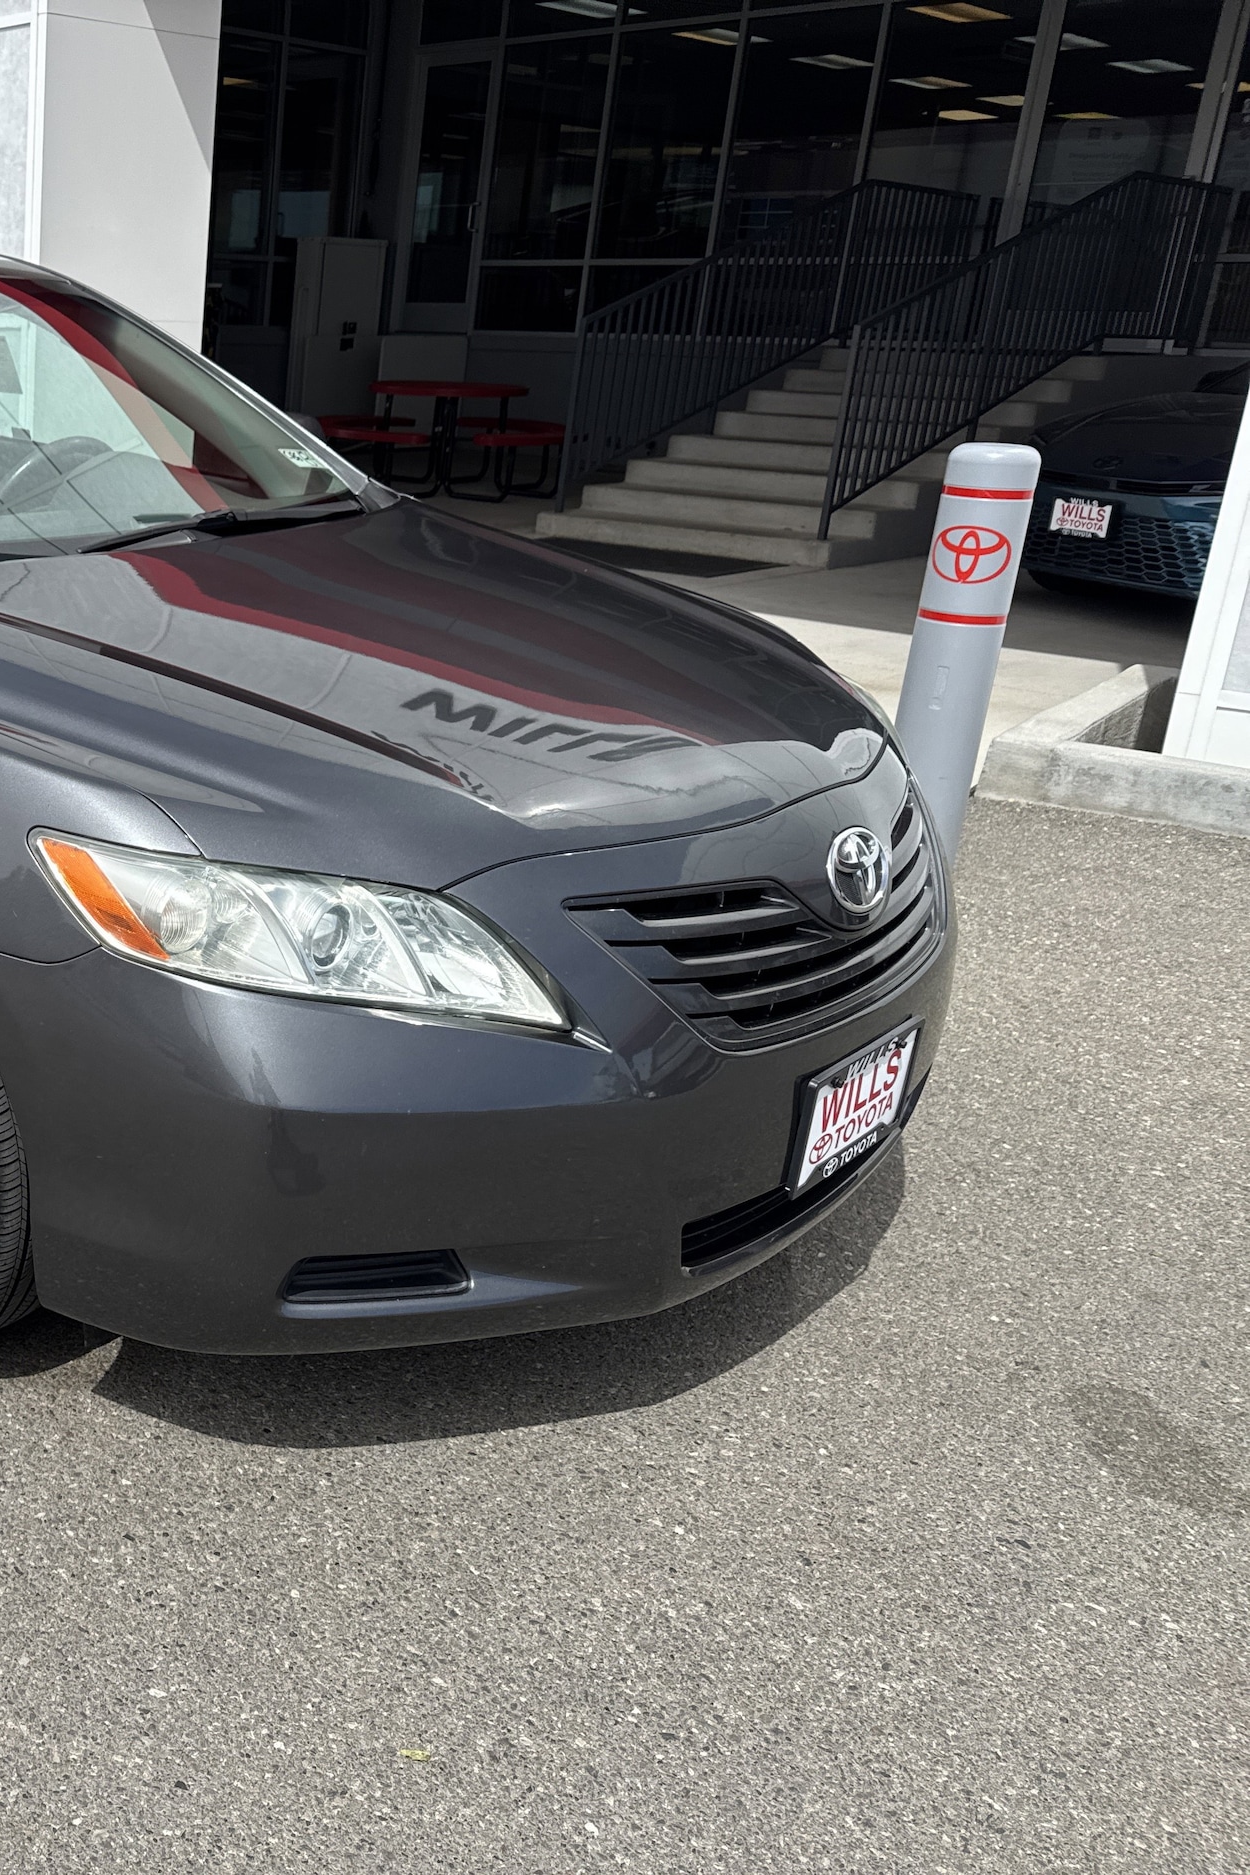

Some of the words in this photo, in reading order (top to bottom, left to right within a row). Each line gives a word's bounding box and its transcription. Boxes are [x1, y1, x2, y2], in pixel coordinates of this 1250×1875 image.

[1062, 503, 1106, 522] WILLS
[1070, 498, 1098, 507] WILLS
[1069, 519, 1103, 532] TOYOTA
[845, 1036, 899, 1079] WILLS
[822, 1049, 902, 1133] WILLS
[834, 1092, 893, 1149] TOYOTA
[840, 1131, 878, 1166] TOYOTA
